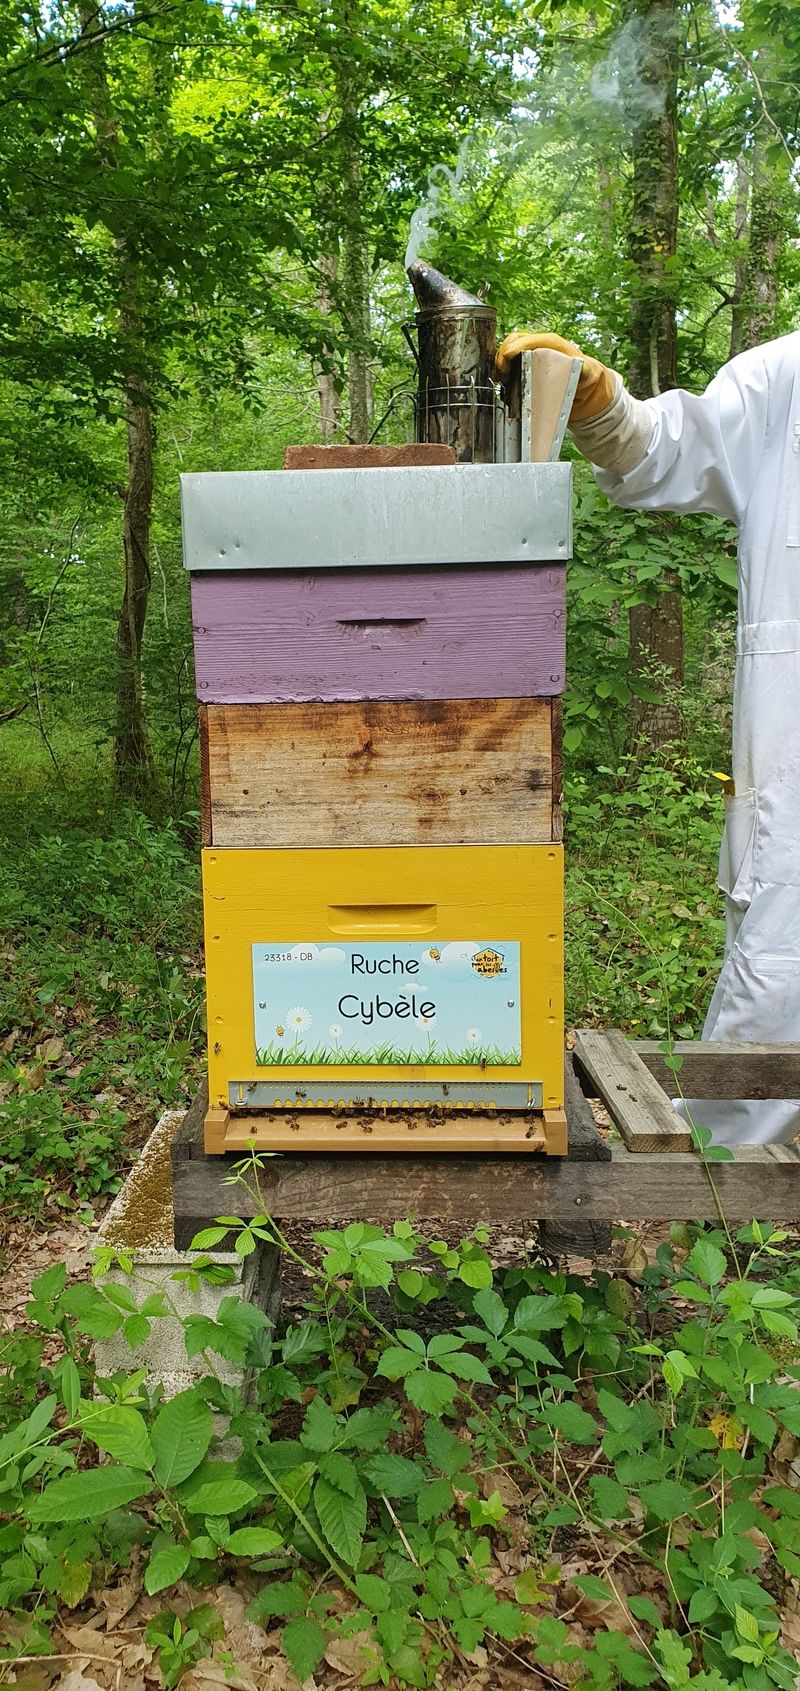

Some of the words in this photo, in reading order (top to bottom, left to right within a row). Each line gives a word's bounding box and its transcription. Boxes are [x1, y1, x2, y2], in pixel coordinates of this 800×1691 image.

[264, 952, 292, 963] 23318
[300, 952, 313, 962] DB
[351, 953, 420, 975] Ruche
[483, 953, 499, 962] toit
[338, 994, 436, 1025] Cybèle
